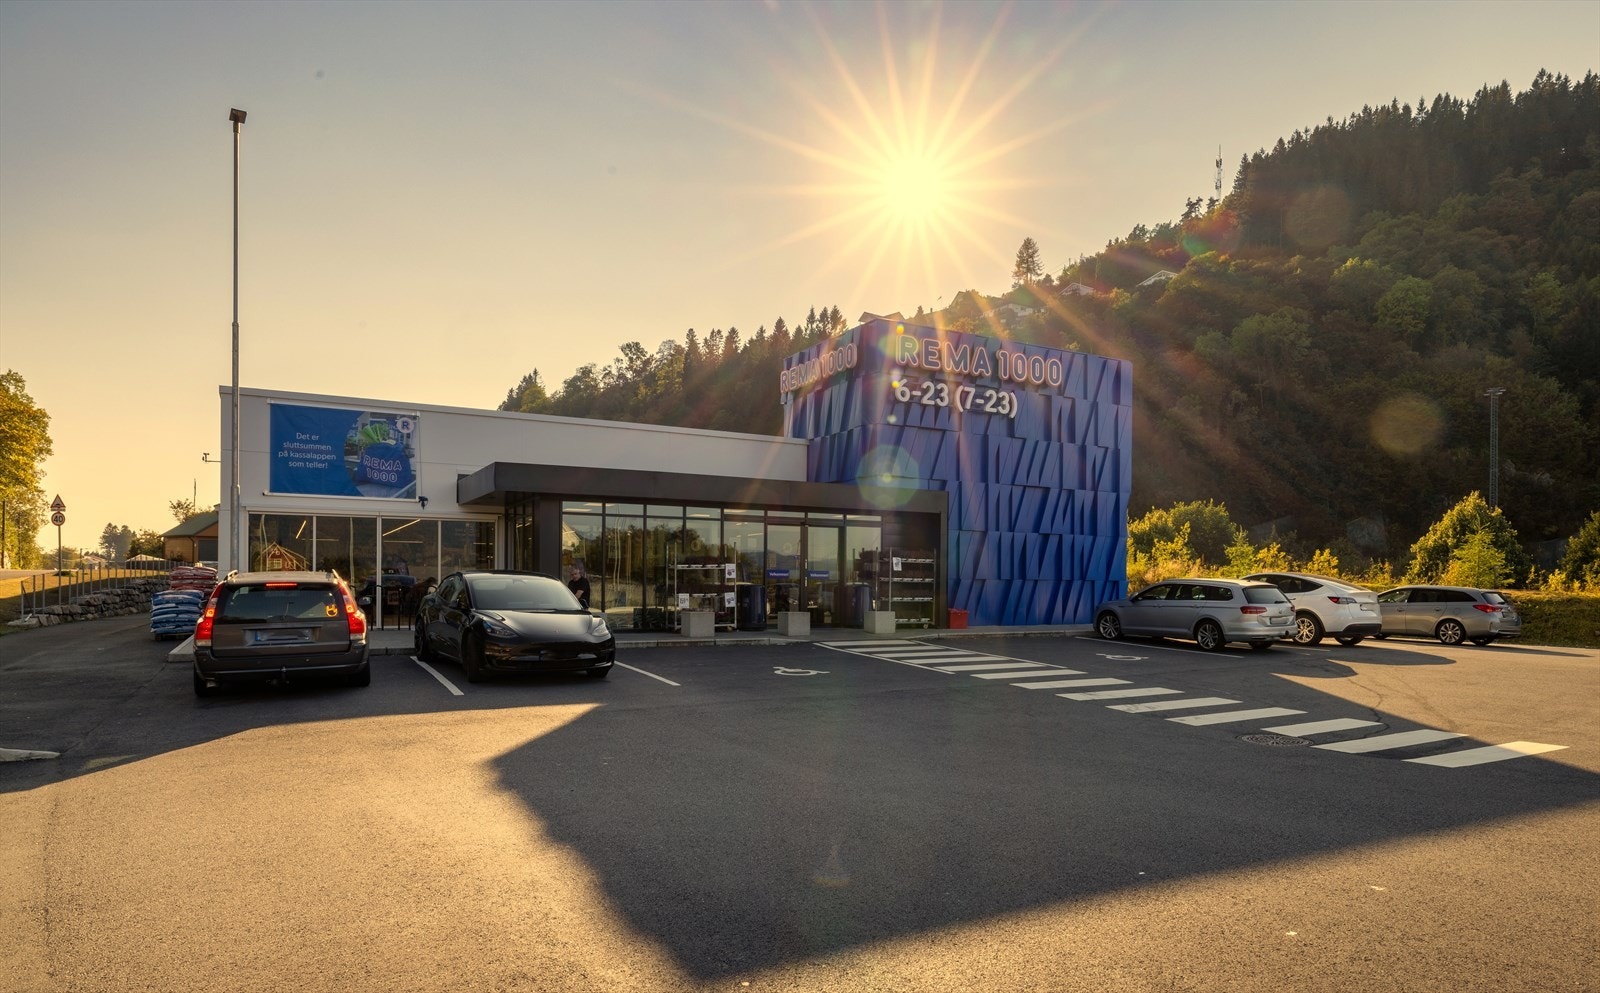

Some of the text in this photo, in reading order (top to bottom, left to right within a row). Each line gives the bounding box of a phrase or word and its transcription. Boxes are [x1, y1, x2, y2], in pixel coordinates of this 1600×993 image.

[896, 335, 1063, 387] REMA 1000
[780, 343, 858, 393] REMA 1000
[894, 378, 1018, 419] 6-23 (7-23)
[402, 421, 409, 429] R
[296, 432, 310, 441] Det
[283, 441, 332, 451] sluttsummen
[278, 450, 337, 461] på kassalappen
[306, 461, 328, 469] teller!
[363, 454, 403, 472] REMA
[366, 468, 398, 483] 1000
[53, 515, 64, 523] 40
